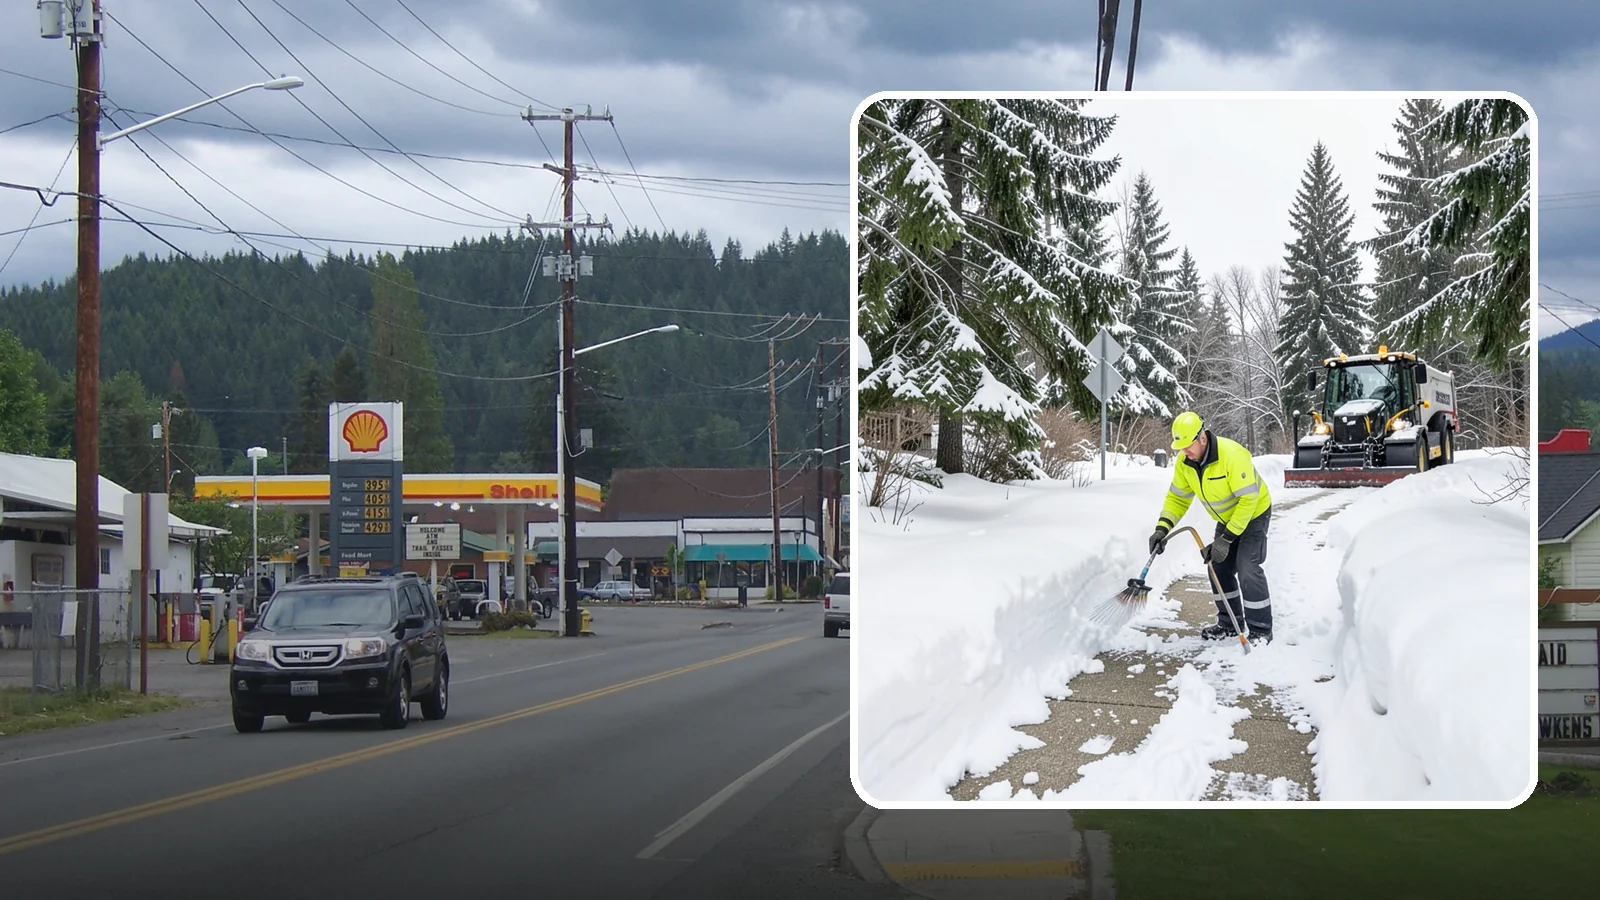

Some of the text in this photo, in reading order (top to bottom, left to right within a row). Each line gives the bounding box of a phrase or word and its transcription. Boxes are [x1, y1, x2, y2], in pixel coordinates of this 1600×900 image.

[366, 480, 383, 490] 395
[490, 484, 547, 499] Shell
[366, 494, 383, 504] 405
[366, 508, 383, 518] 415
[366, 522, 383, 532] 429
[1538, 643, 1567, 665] AID
[1538, 715, 1592, 739] WKENS
